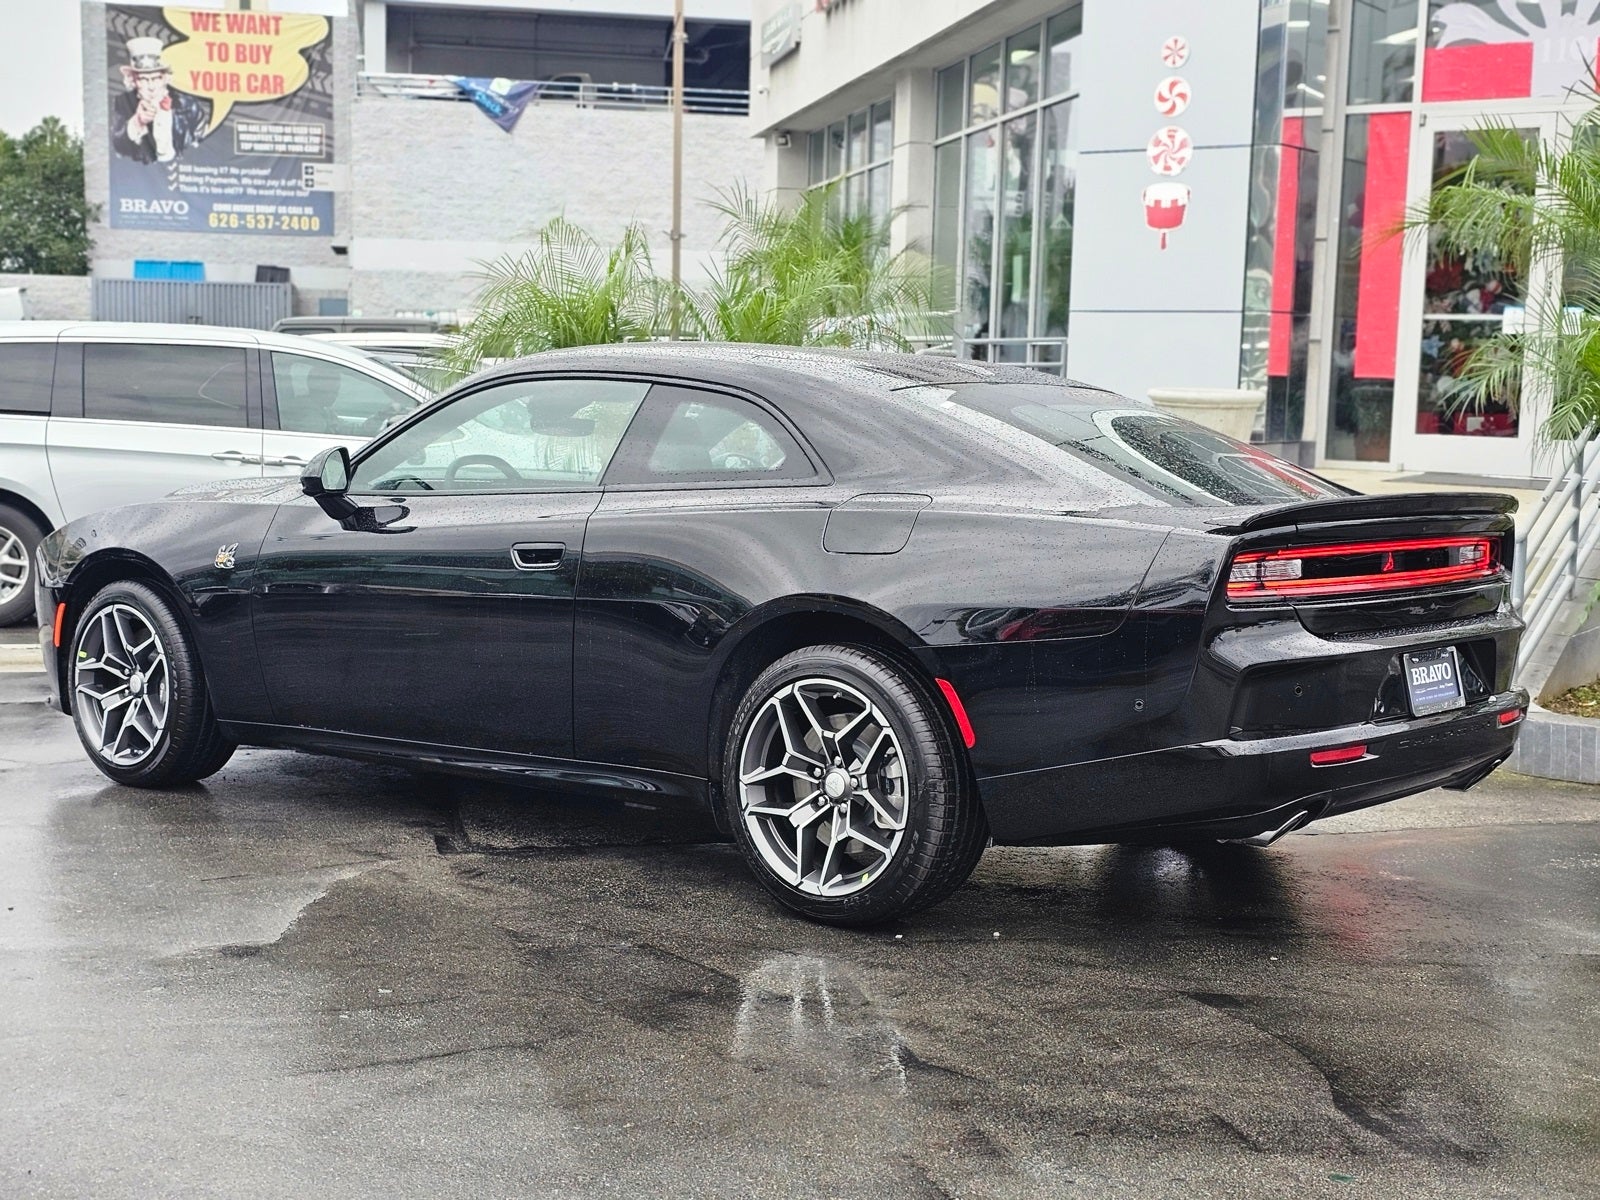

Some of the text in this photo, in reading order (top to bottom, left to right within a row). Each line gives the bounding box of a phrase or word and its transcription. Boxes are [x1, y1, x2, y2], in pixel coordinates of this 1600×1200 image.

[190, 12, 283, 36] WE WANT
[206, 42, 272, 65] TO BUY
[190, 70, 285, 94] YOUR CAR
[119, 198, 190, 215] BRAVO
[208, 213, 320, 231] 626-537-2400
[1410, 662, 1452, 686] BRAVO
